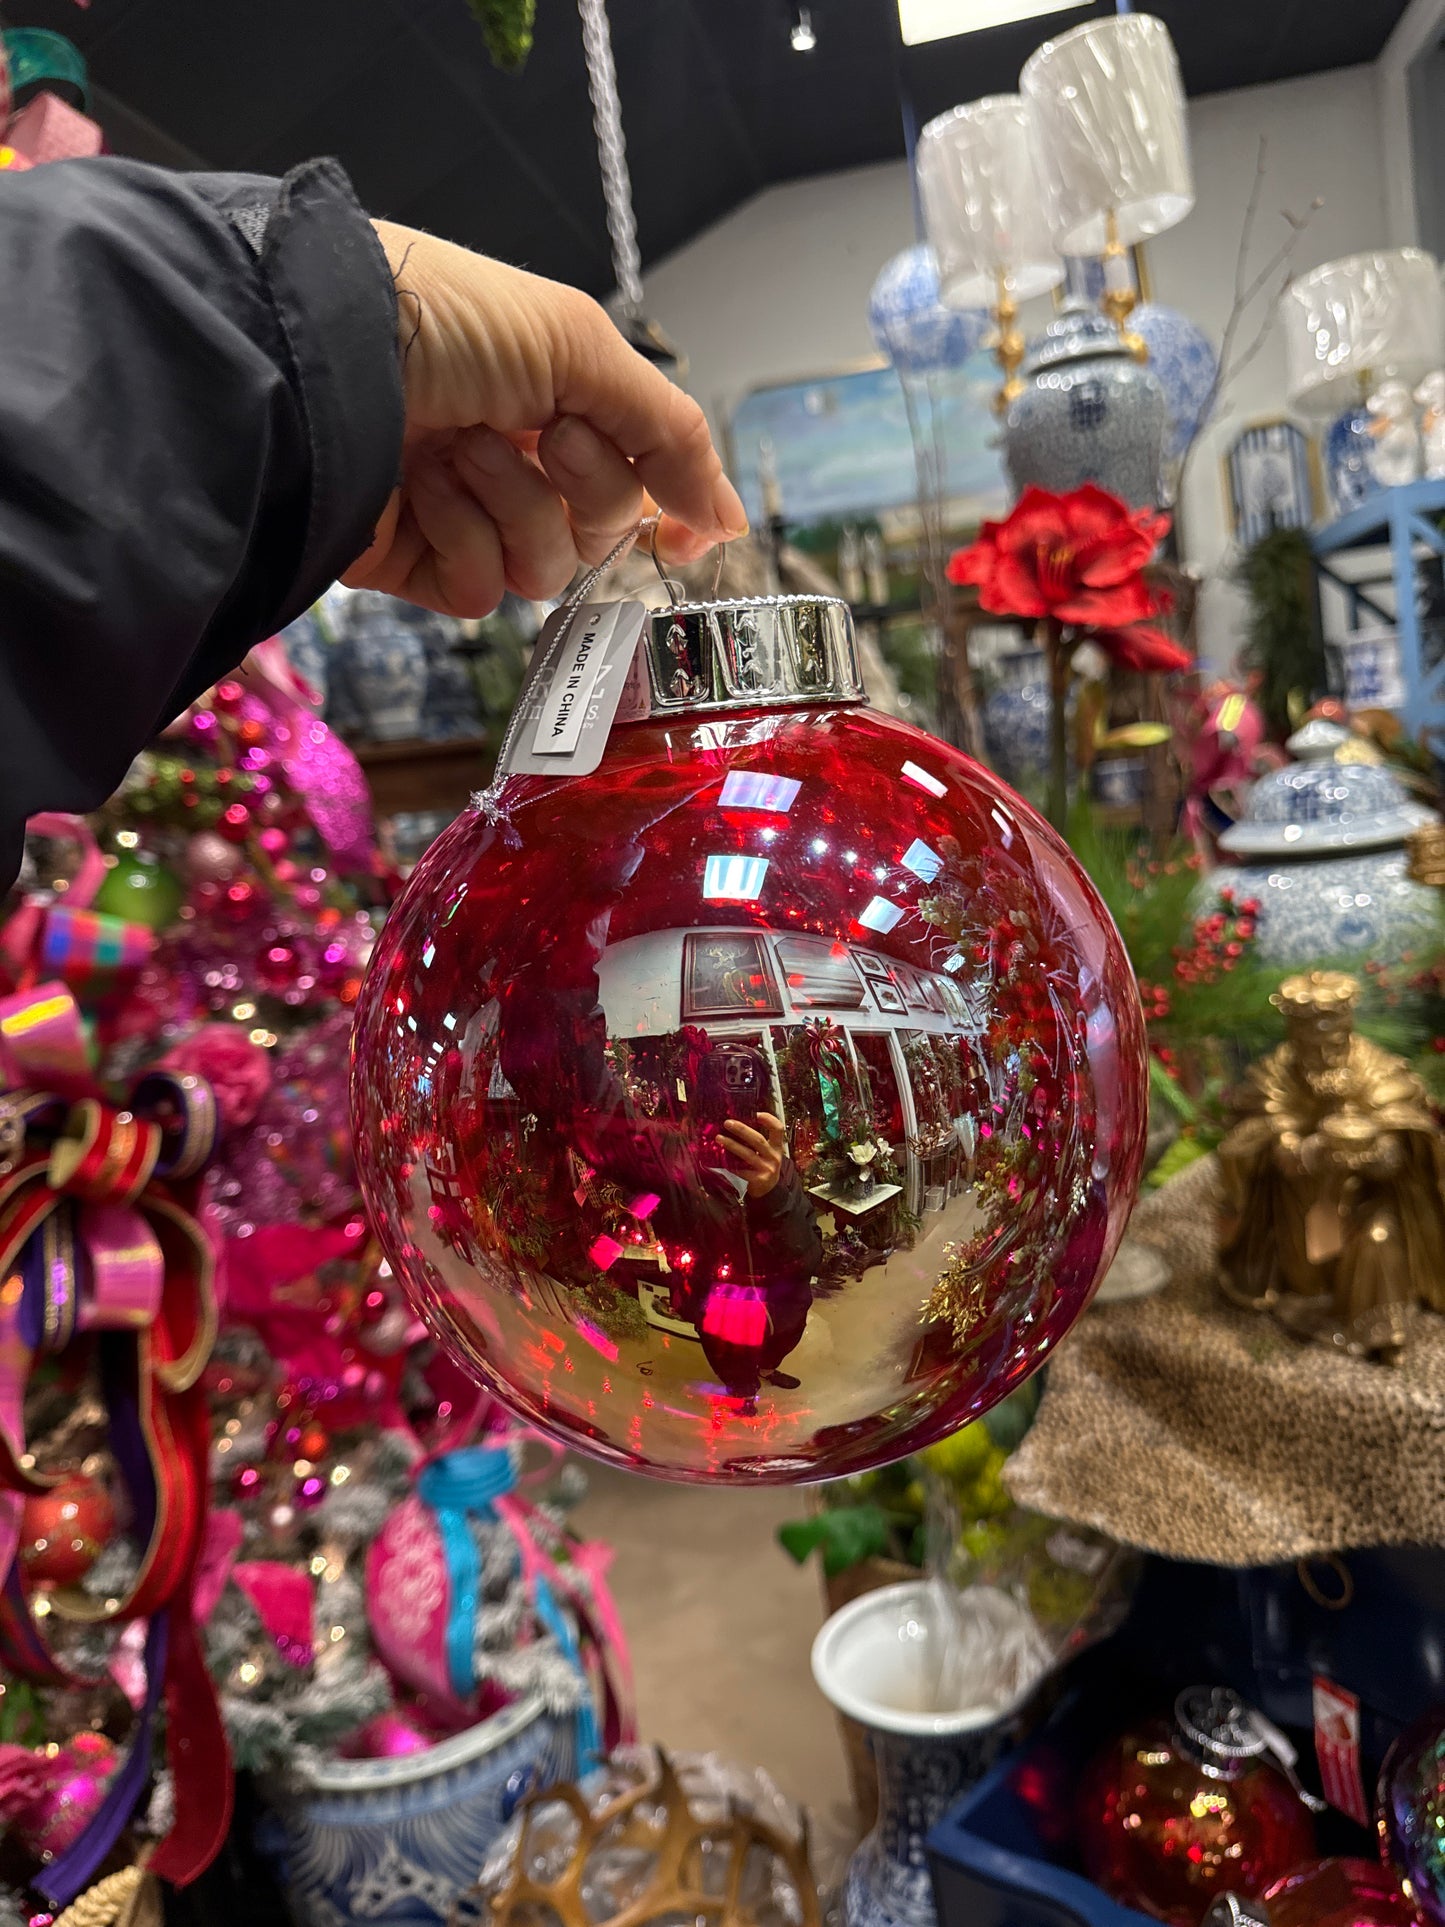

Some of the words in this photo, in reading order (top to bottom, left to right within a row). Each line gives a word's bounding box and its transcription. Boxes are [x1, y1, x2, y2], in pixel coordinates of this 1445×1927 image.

[572, 632, 596, 672] MADE
[566, 675, 581, 689] IN
[551, 693, 575, 737] CHINA
